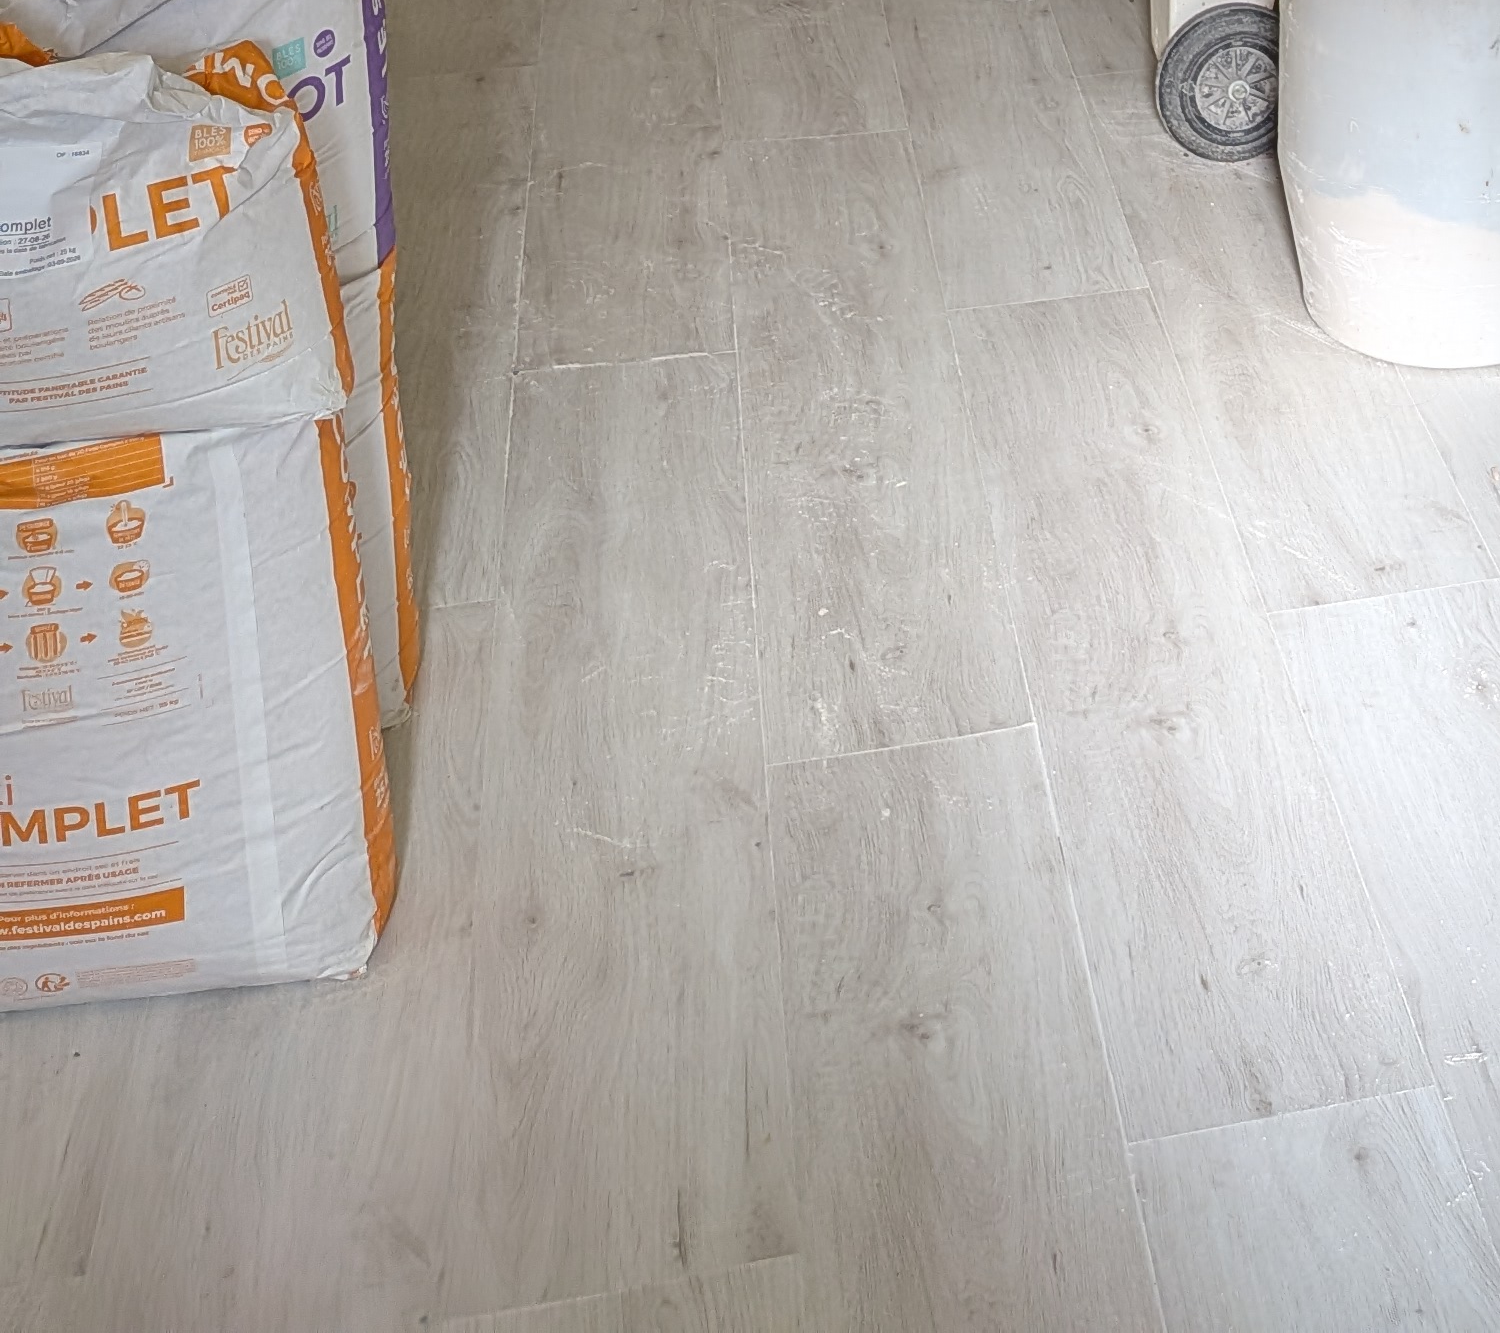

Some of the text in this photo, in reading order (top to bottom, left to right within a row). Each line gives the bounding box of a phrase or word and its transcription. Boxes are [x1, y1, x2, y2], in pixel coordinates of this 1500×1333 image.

[195, 136, 226, 149] 100%
[89, 166, 238, 252] LET
[211, 291, 250, 311] Certipaq
[213, 298, 293, 370] Festival
[243, 333, 293, 360] DES PAINS
[98, 367, 148, 383] GARANTIE
[31, 391, 77, 402] FESTIVAL
[0, 779, 200, 847] MPLET
[7, 878, 64, 889] REFERMER
[24, 910, 48, 922] plus
[50, 904, 129, 920] d'informations
